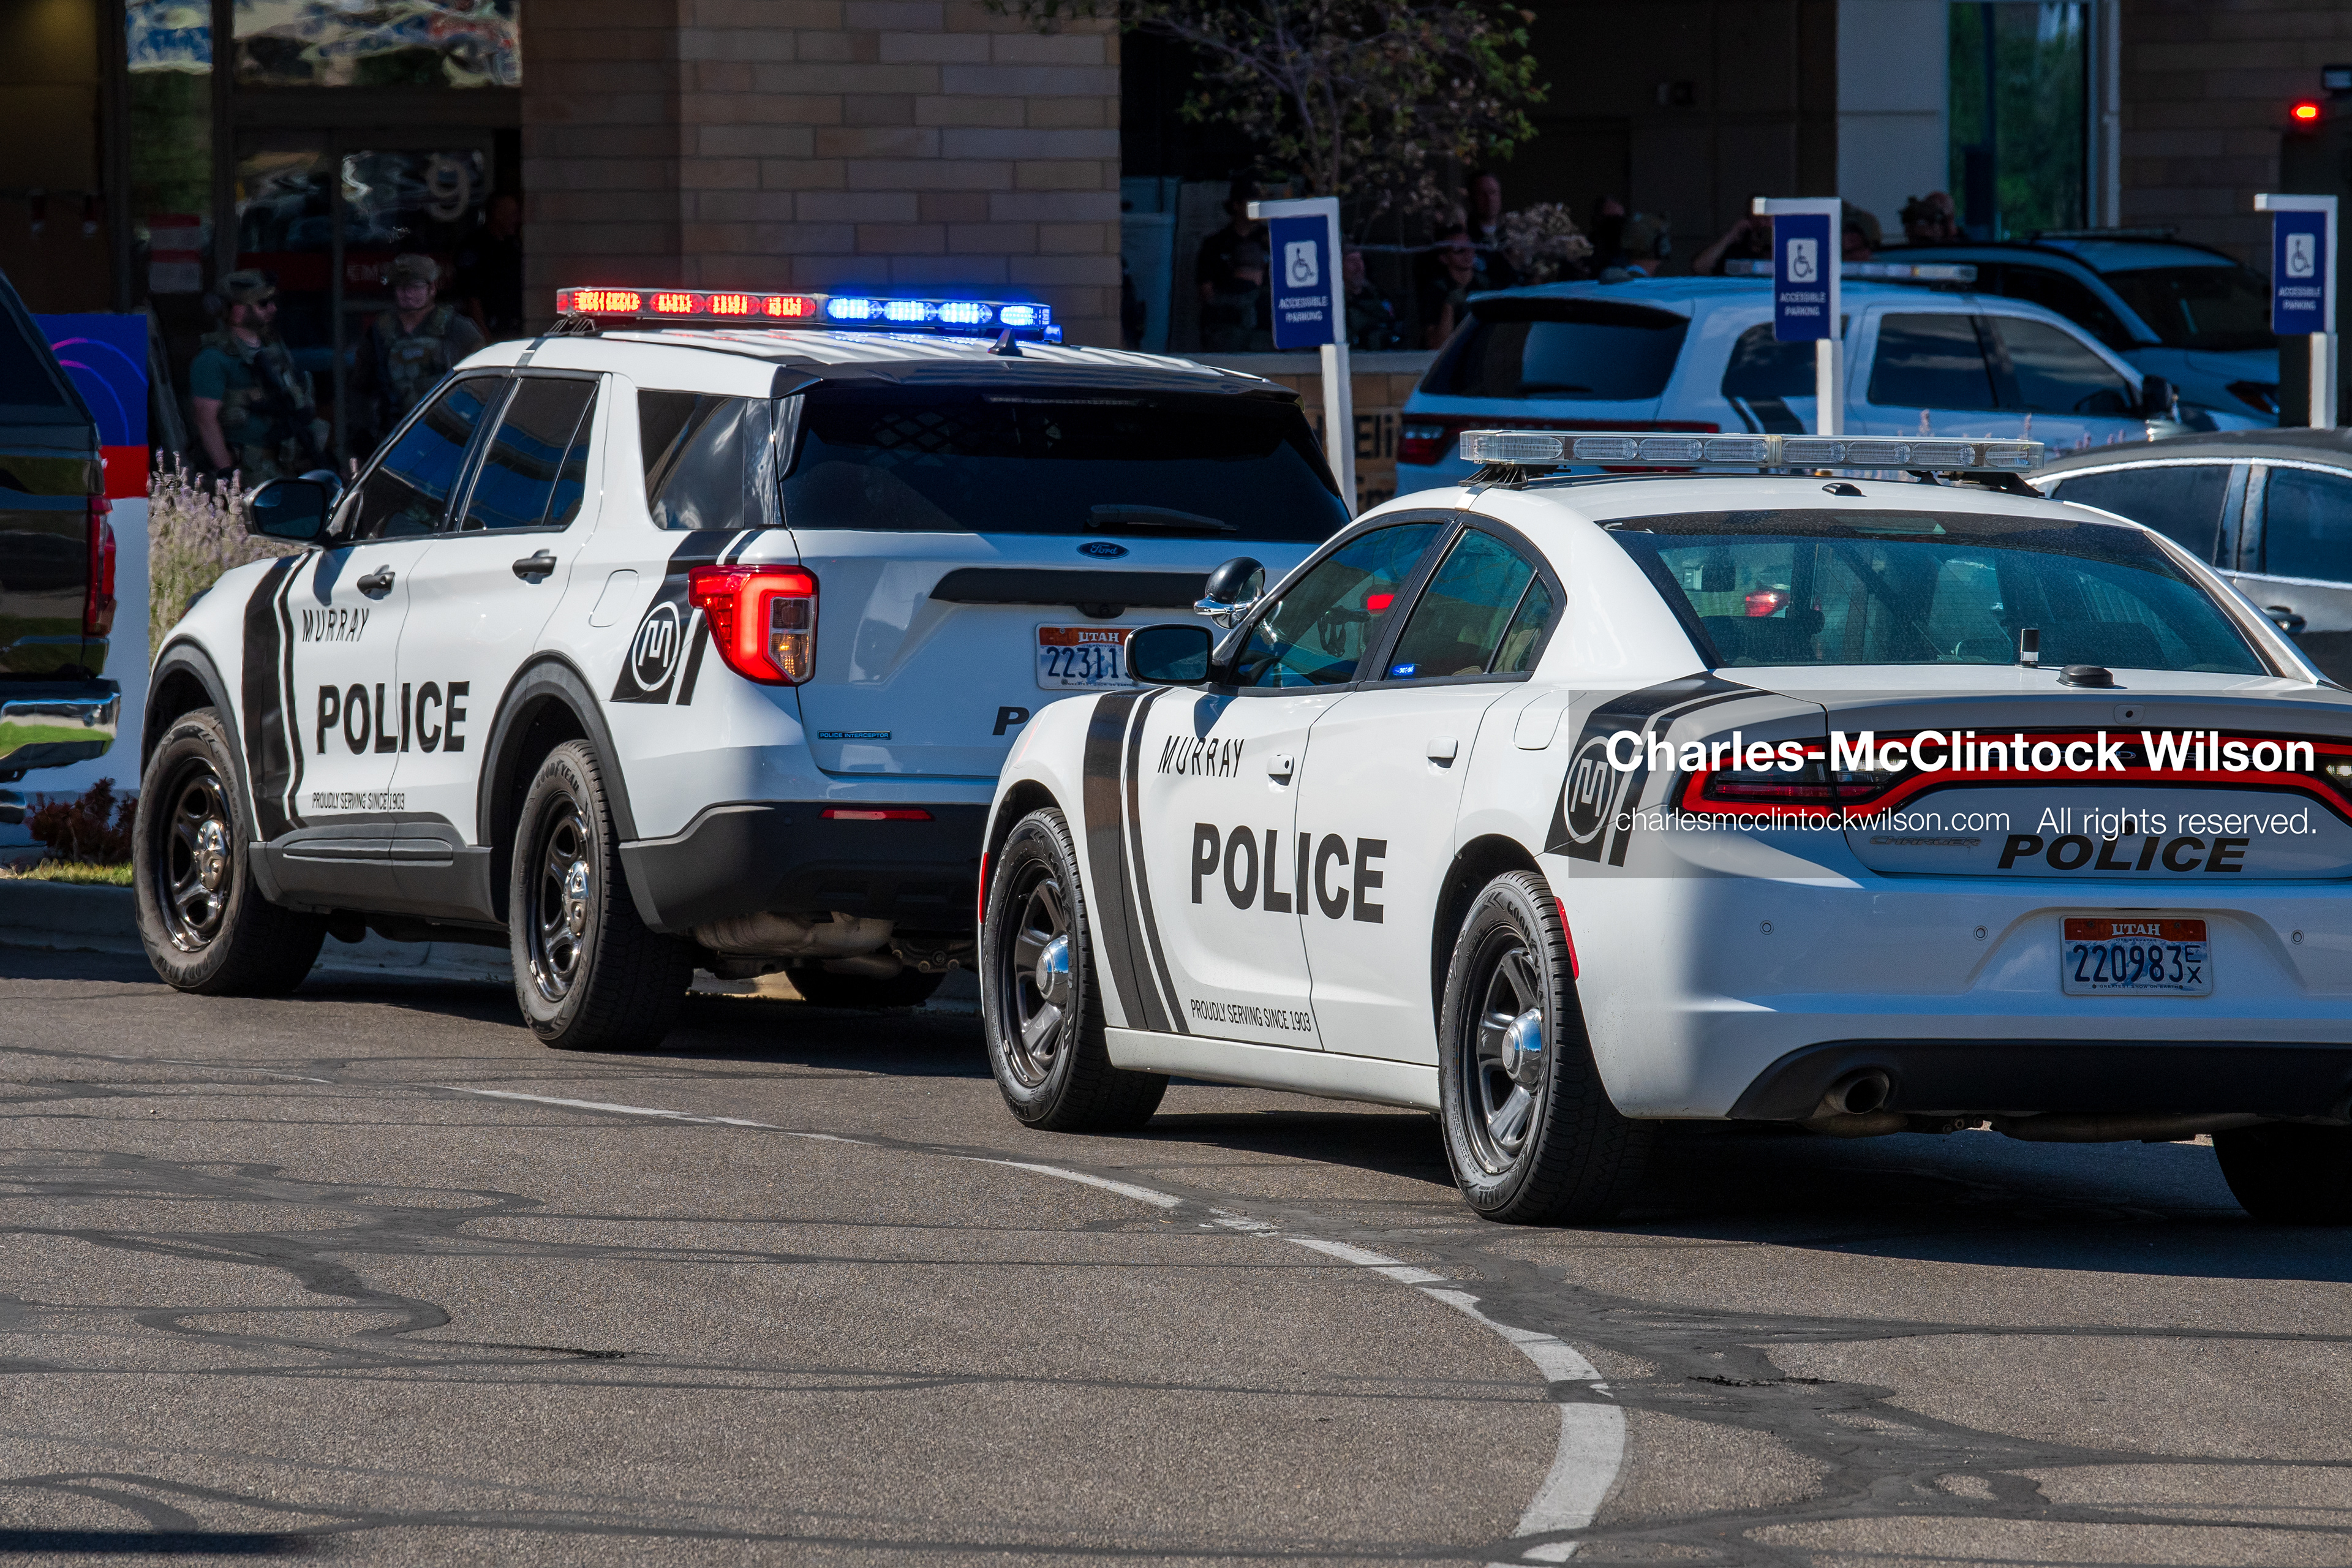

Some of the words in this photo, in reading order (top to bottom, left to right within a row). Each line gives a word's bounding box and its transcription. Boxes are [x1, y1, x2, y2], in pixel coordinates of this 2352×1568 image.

[428, 154, 471, 222] 9
[1779, 292, 1826, 303] ACCESSIBLE
[2278, 287, 2321, 297] ACCESSIBLE
[1278, 296, 1329, 309] ACCESSIBLE
[2282, 300, 2316, 311] PARKING
[1285, 311, 1323, 323] PARKING
[1784, 306, 1820, 316] PARKING
[1090, 544, 1118, 554] Ford
[301, 608, 369, 642] MURRAY
[1078, 632, 1120, 643] UTAH
[1047, 646, 1132, 679] 22311
[317, 680, 470, 755] POLICE
[1157, 735, 1245, 778] MURRAY
[312, 792, 340, 809] PROUDLY
[340, 792, 366, 810] SERVING
[368, 792, 388, 810] SINCE
[389, 793, 405, 810] 1903
[1870, 835, 1981, 847] CHARGER
[1997, 834, 2251, 872] POLICE
[1191, 822, 1387, 924] POLICE
[2111, 924, 2161, 936] UTAH
[2073, 945, 2184, 982] 220983
[1191, 999, 1226, 1022] PROUDLY
[1227, 1004, 1263, 1027] SERVING
[1264, 1008, 1289, 1029] SINCE
[1290, 1011, 1311, 1031] 1903
